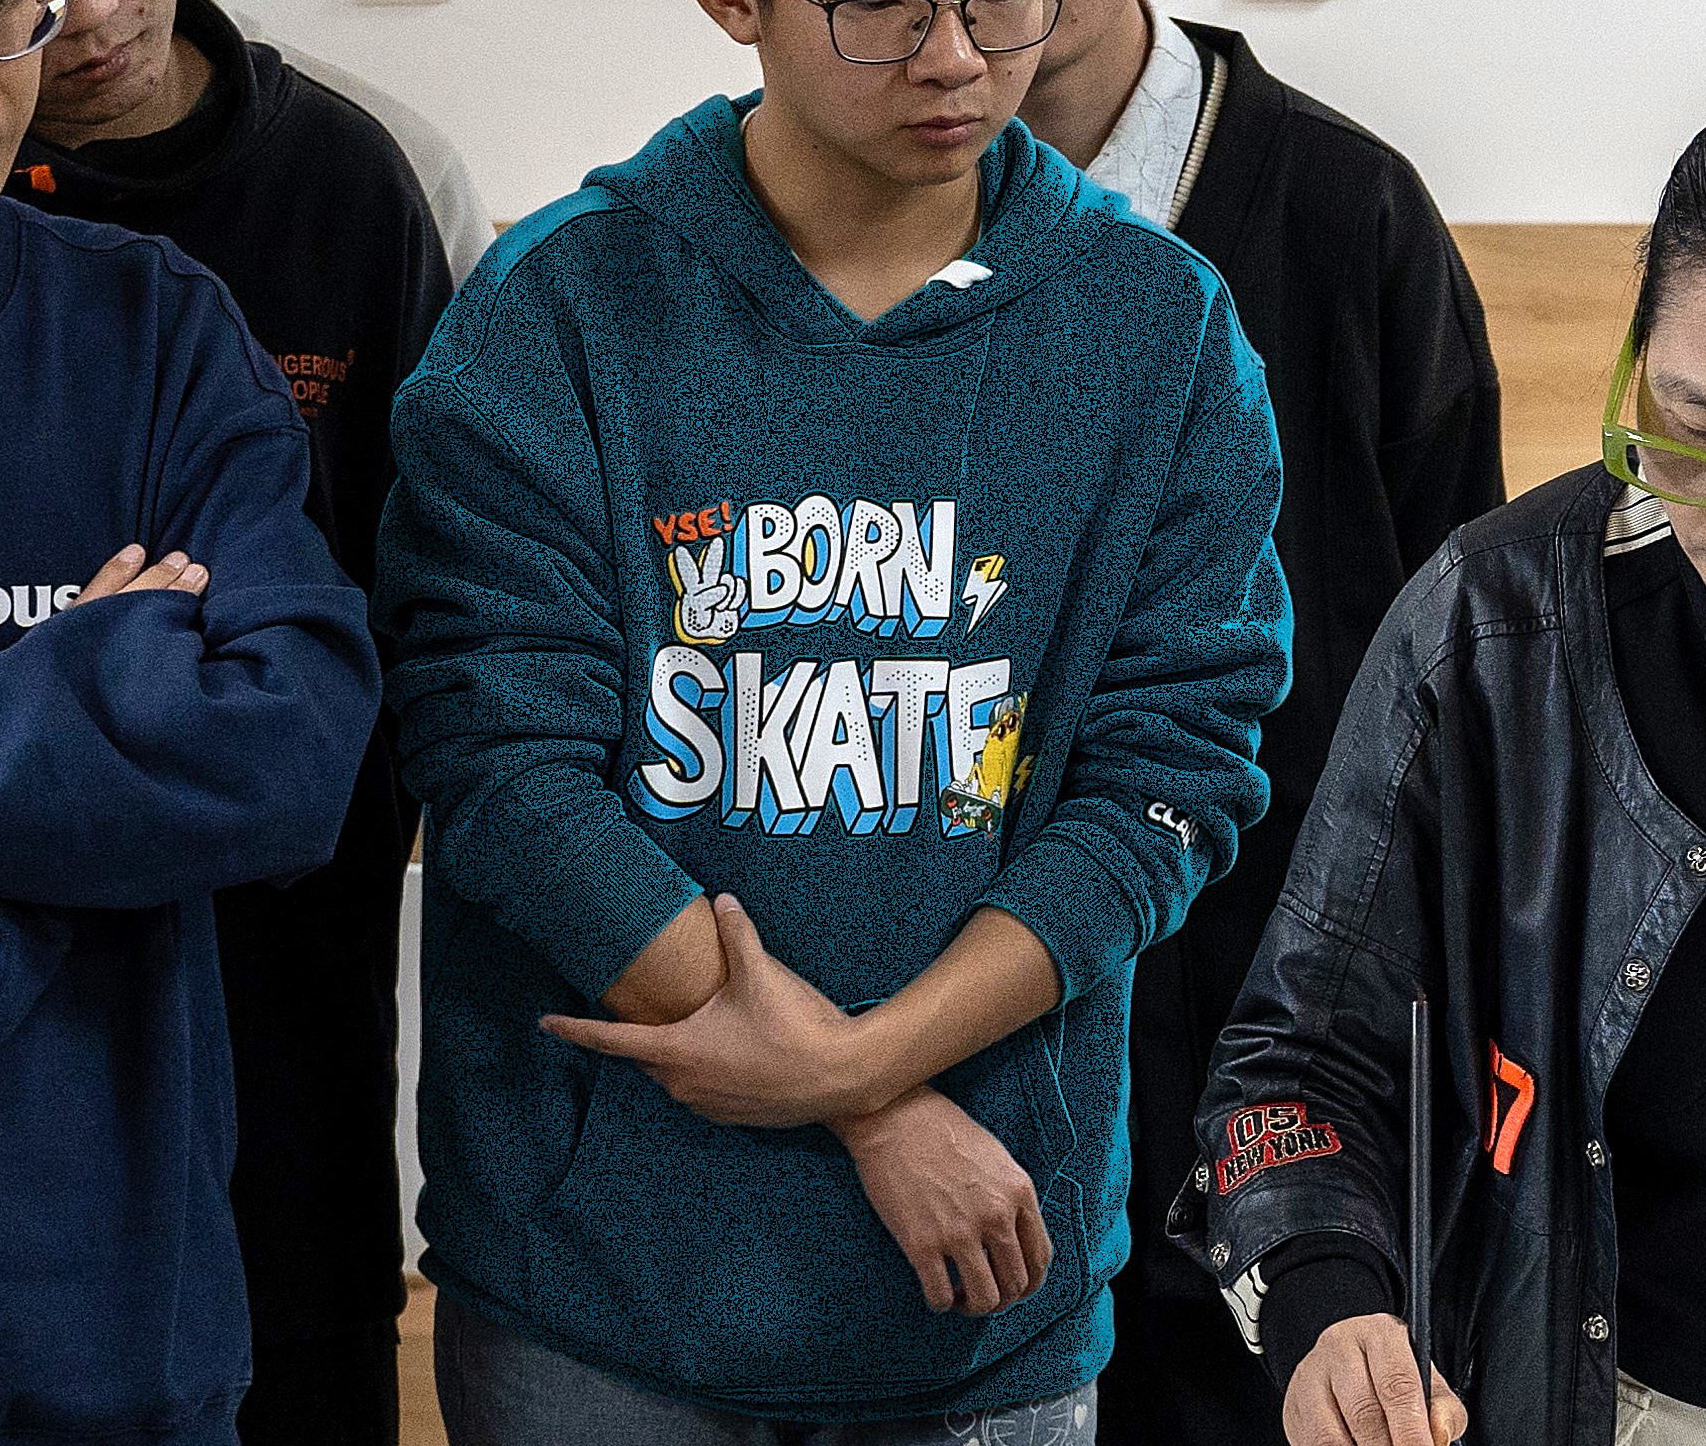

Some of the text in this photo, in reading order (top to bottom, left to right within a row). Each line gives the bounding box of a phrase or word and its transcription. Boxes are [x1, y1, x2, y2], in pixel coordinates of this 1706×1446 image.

[739, 495, 956, 631] BORN
[630, 645, 1011, 837] SKATE
[1223, 1128, 1334, 1189] NEW YORK
[1233, 1106, 1301, 1151] 05
